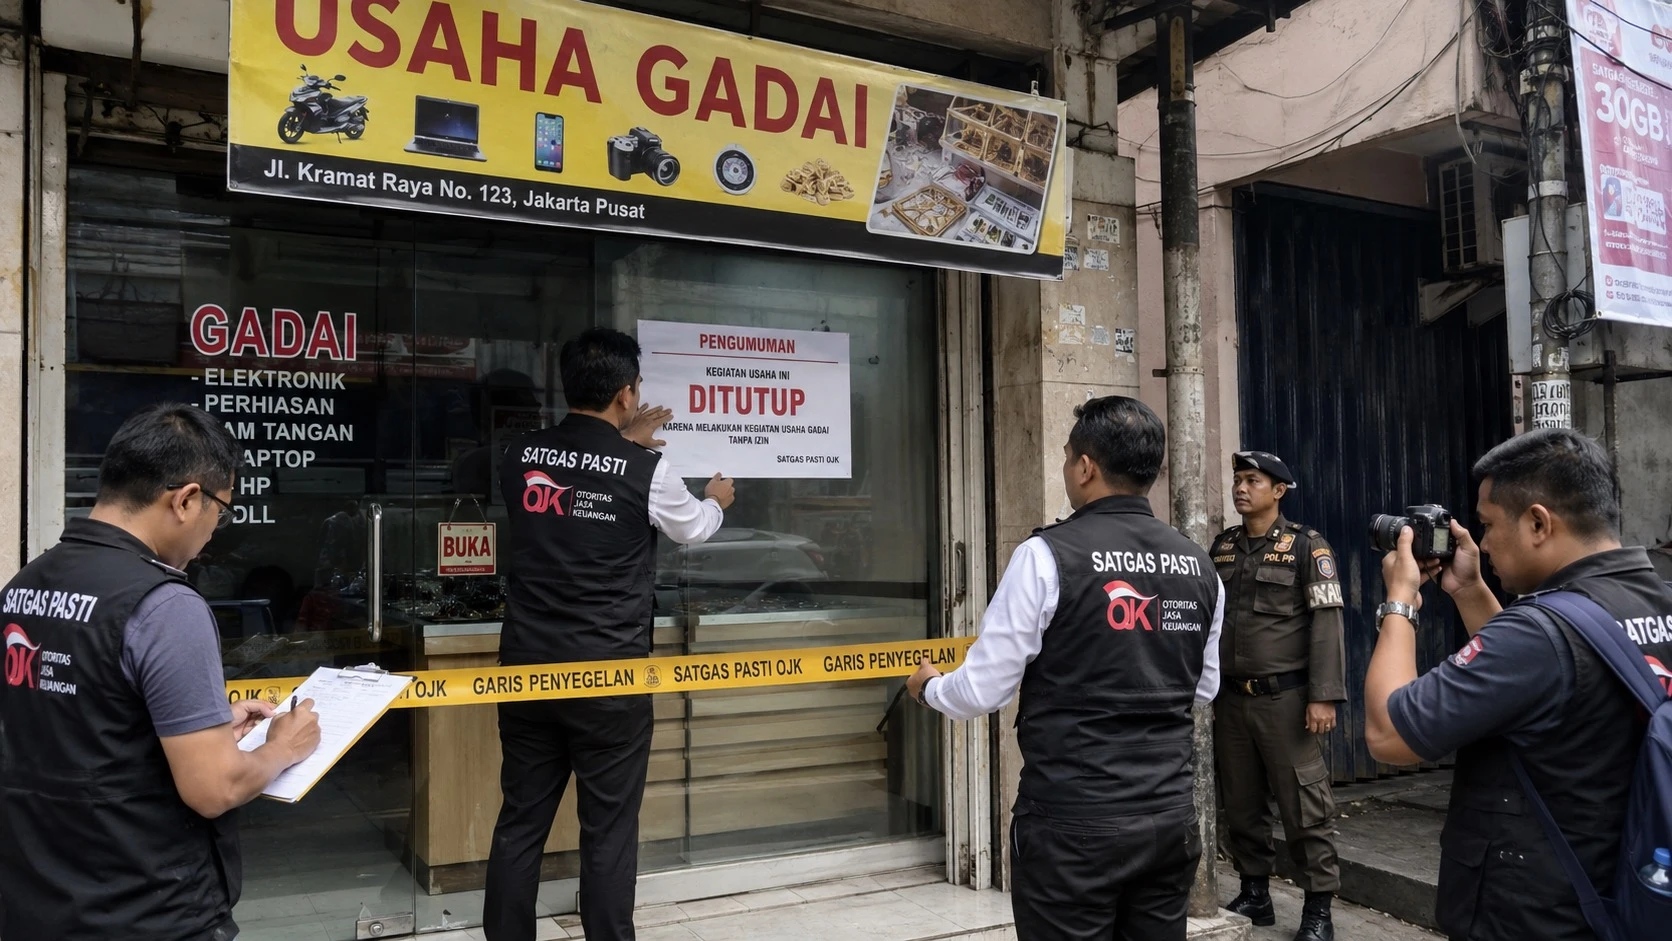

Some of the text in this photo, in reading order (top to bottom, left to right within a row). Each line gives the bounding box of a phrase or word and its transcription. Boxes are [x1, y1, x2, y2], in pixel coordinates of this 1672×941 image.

[275, 0, 868, 149] USAHA GADAI
[1595, 81, 1664, 141] 30GB
[263, 158, 646, 219] Jl. Kramat Raya No. 123, Jakarta Pusat
[190, 303, 357, 361] GADAI
[699, 333, 796, 354] PENGUMUMAN
[205, 367, 346, 390] ELEKTRONIK
[706, 366, 790, 380] KEGIATAN USAHA INI
[205, 393, 335, 415] PERHIASAN
[689, 384, 806, 416] DITUTUP
[262, 422, 354, 442] TANGAN
[662, 422, 829, 434] KARENA MELAKUKAN KEGIATAN USAHA GADAI
[728, 435, 769, 445] TANPA IZIN
[243, 449, 316, 468] APTOP
[521, 446, 628, 476] SATGAS PASTI
[777, 455, 840, 464] SATGAS PASTI OJK
[240, 476, 271, 495] HP
[522, 484, 566, 516] OJK
[573, 500, 593, 509] JASA
[575, 490, 613, 503] OTORITAS
[572, 509, 617, 522] KEUANGAN
[443, 535, 491, 558] BUKA
[1091, 551, 1201, 576] SATGAS PASTI
[1263, 553, 1296, 563] POL PP
[2, 588, 98, 623] SATGAS PASTI
[1106, 598, 1153, 631] OJK
[1162, 600, 1198, 610] OTORITAS
[1162, 610, 1181, 620] JASA
[1162, 622, 1201, 632] KEUANGAN
[5, 645, 37, 689] OJK
[673, 658, 803, 683] SATGAS PASTI OJK
[823, 653, 865, 673] GARIS
[415, 680, 447, 698] OJK
[473, 668, 635, 695] GARIS PENYEGELAN
